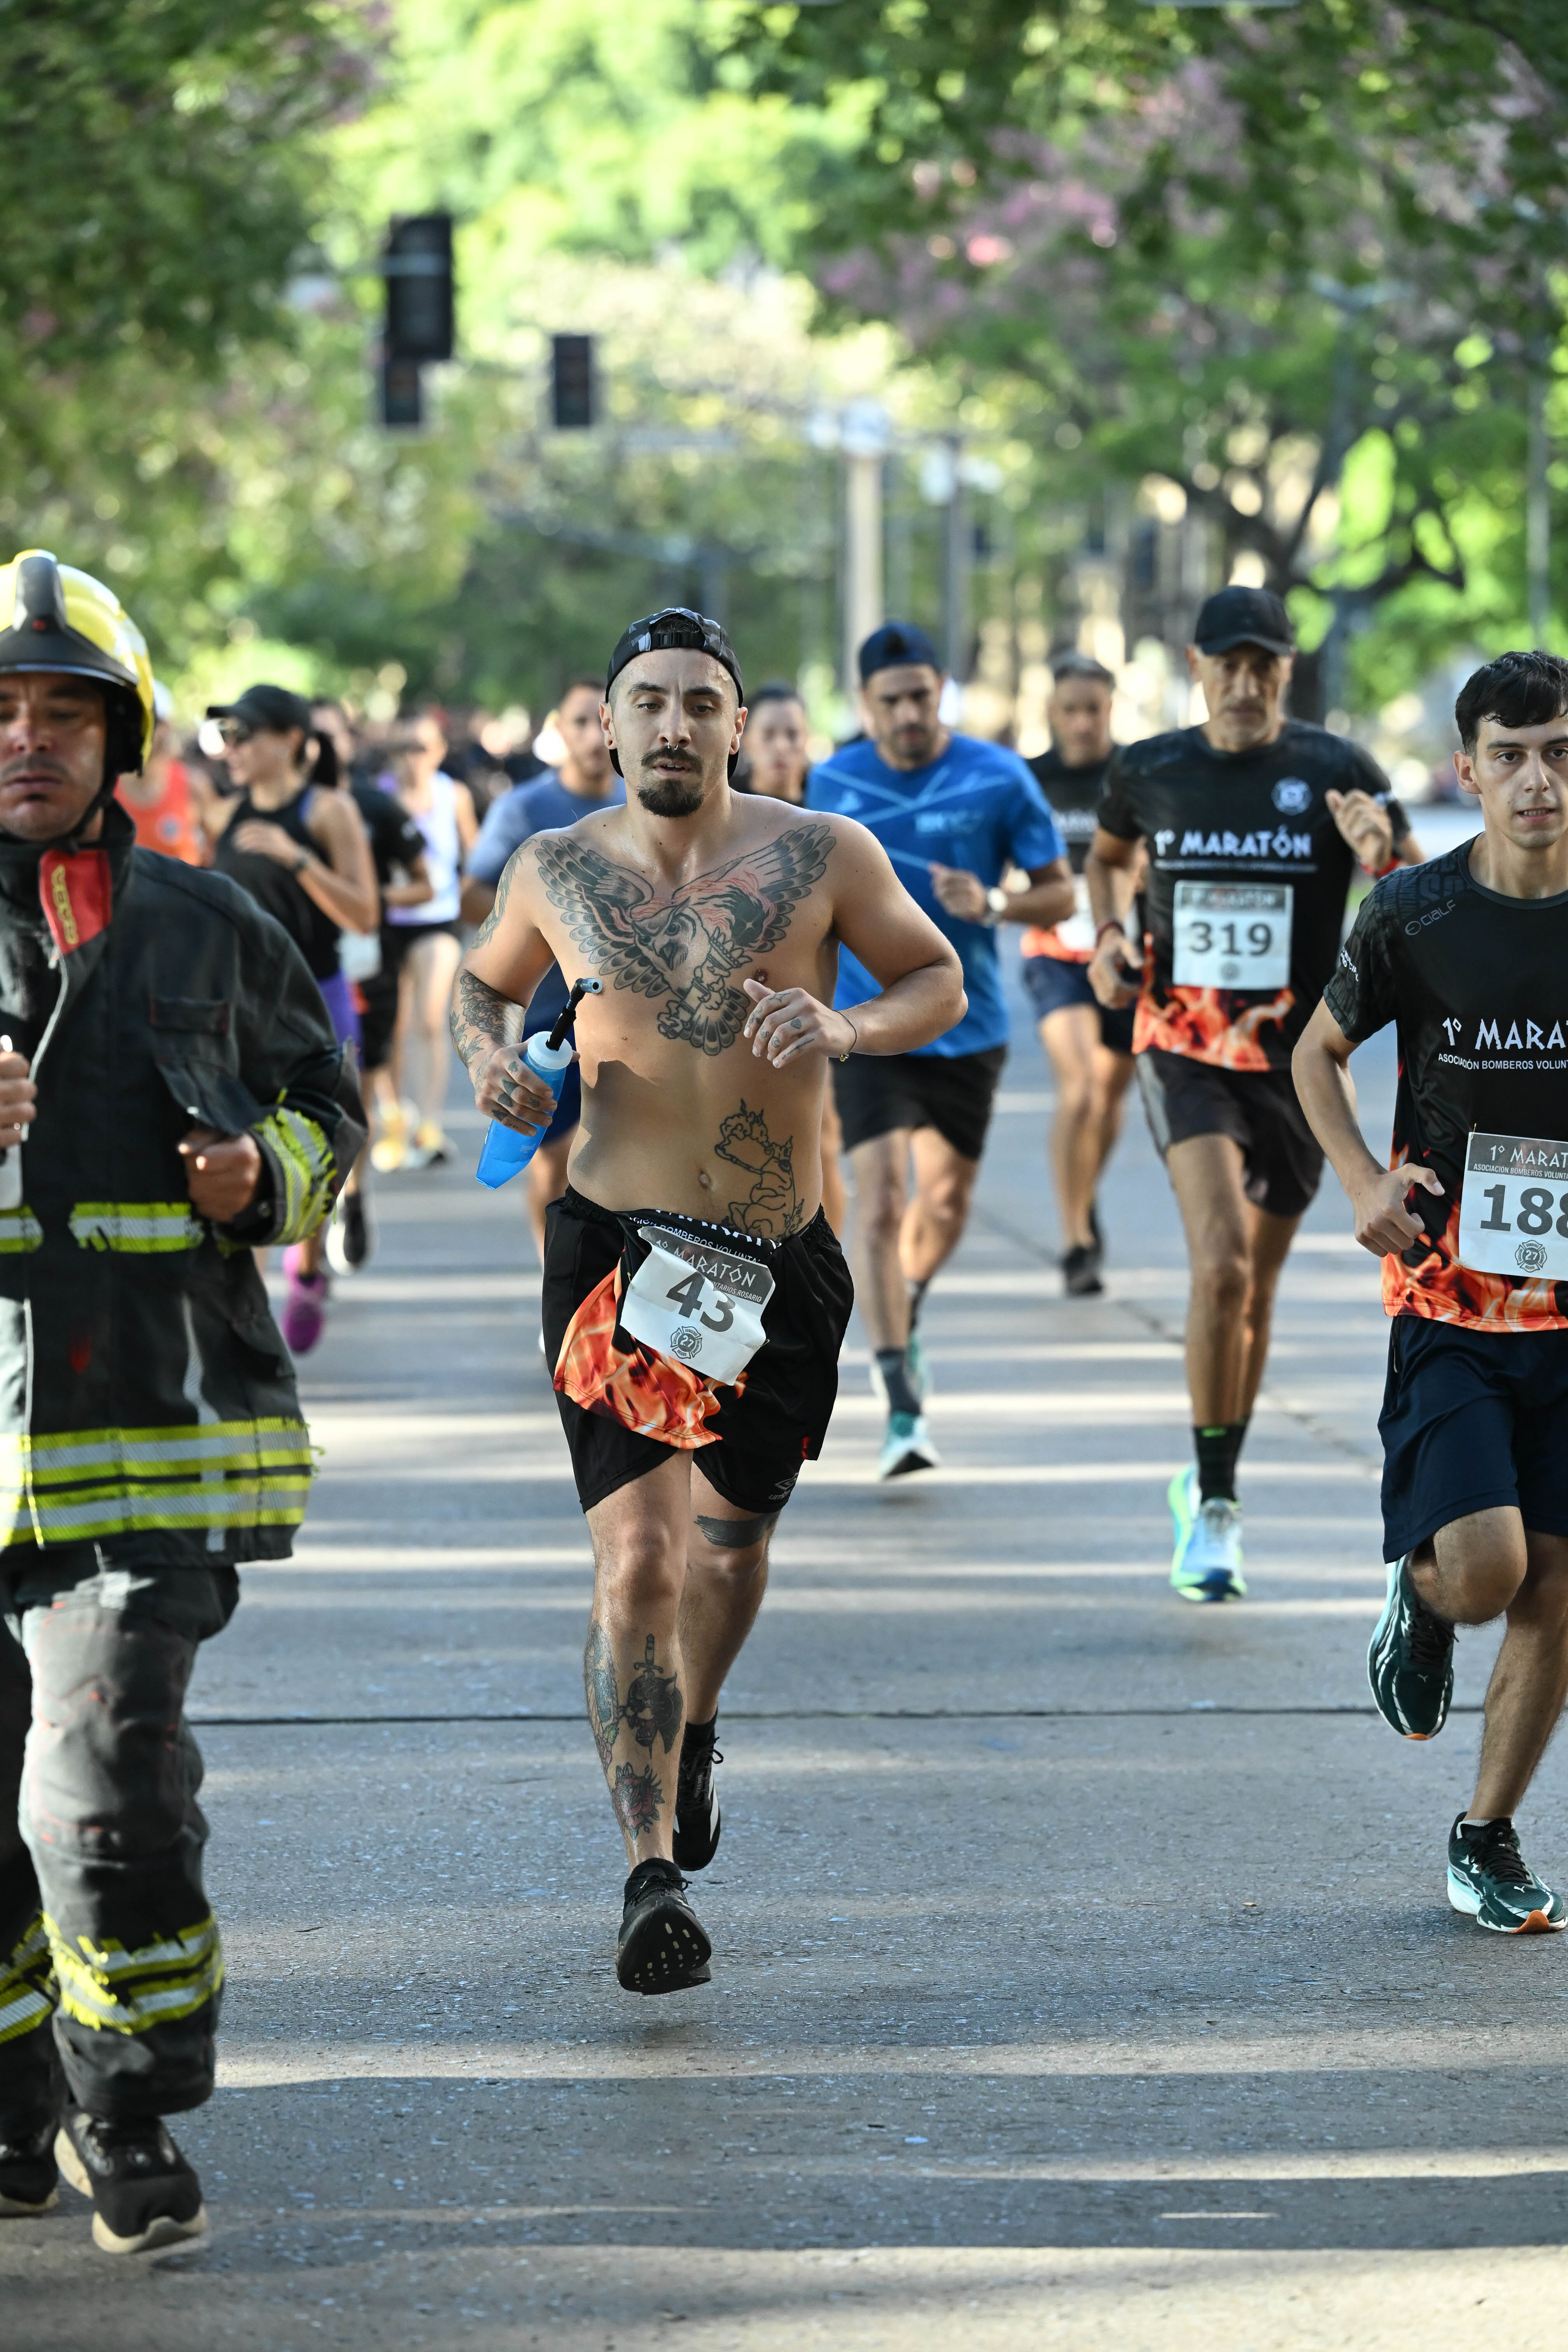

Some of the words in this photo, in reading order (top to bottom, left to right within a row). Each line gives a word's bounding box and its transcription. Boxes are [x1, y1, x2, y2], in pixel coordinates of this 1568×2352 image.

[1180, 824, 1311, 858] MARATÓN
[1190, 922, 1272, 956] 319
[1475, 1018, 1568, 1050] MARA
[1438, 1053, 1479, 1070] ASOCIACIÓN
[1482, 1060, 1533, 1069] BOMBEROS
[1536, 1060, 1568, 1069] VOLUN
[1473, 1163, 1508, 1174] ASOCIACIÓN
[1510, 1167, 1543, 1177] BOMBEROS
[1525, 1250, 1538, 1260] 27
[674, 1247, 756, 1288] MARATÓN
[666, 1270, 735, 1332] 43
[737, 1289, 762, 1303] ROSARIO
[680, 1335, 694, 1348] 27
